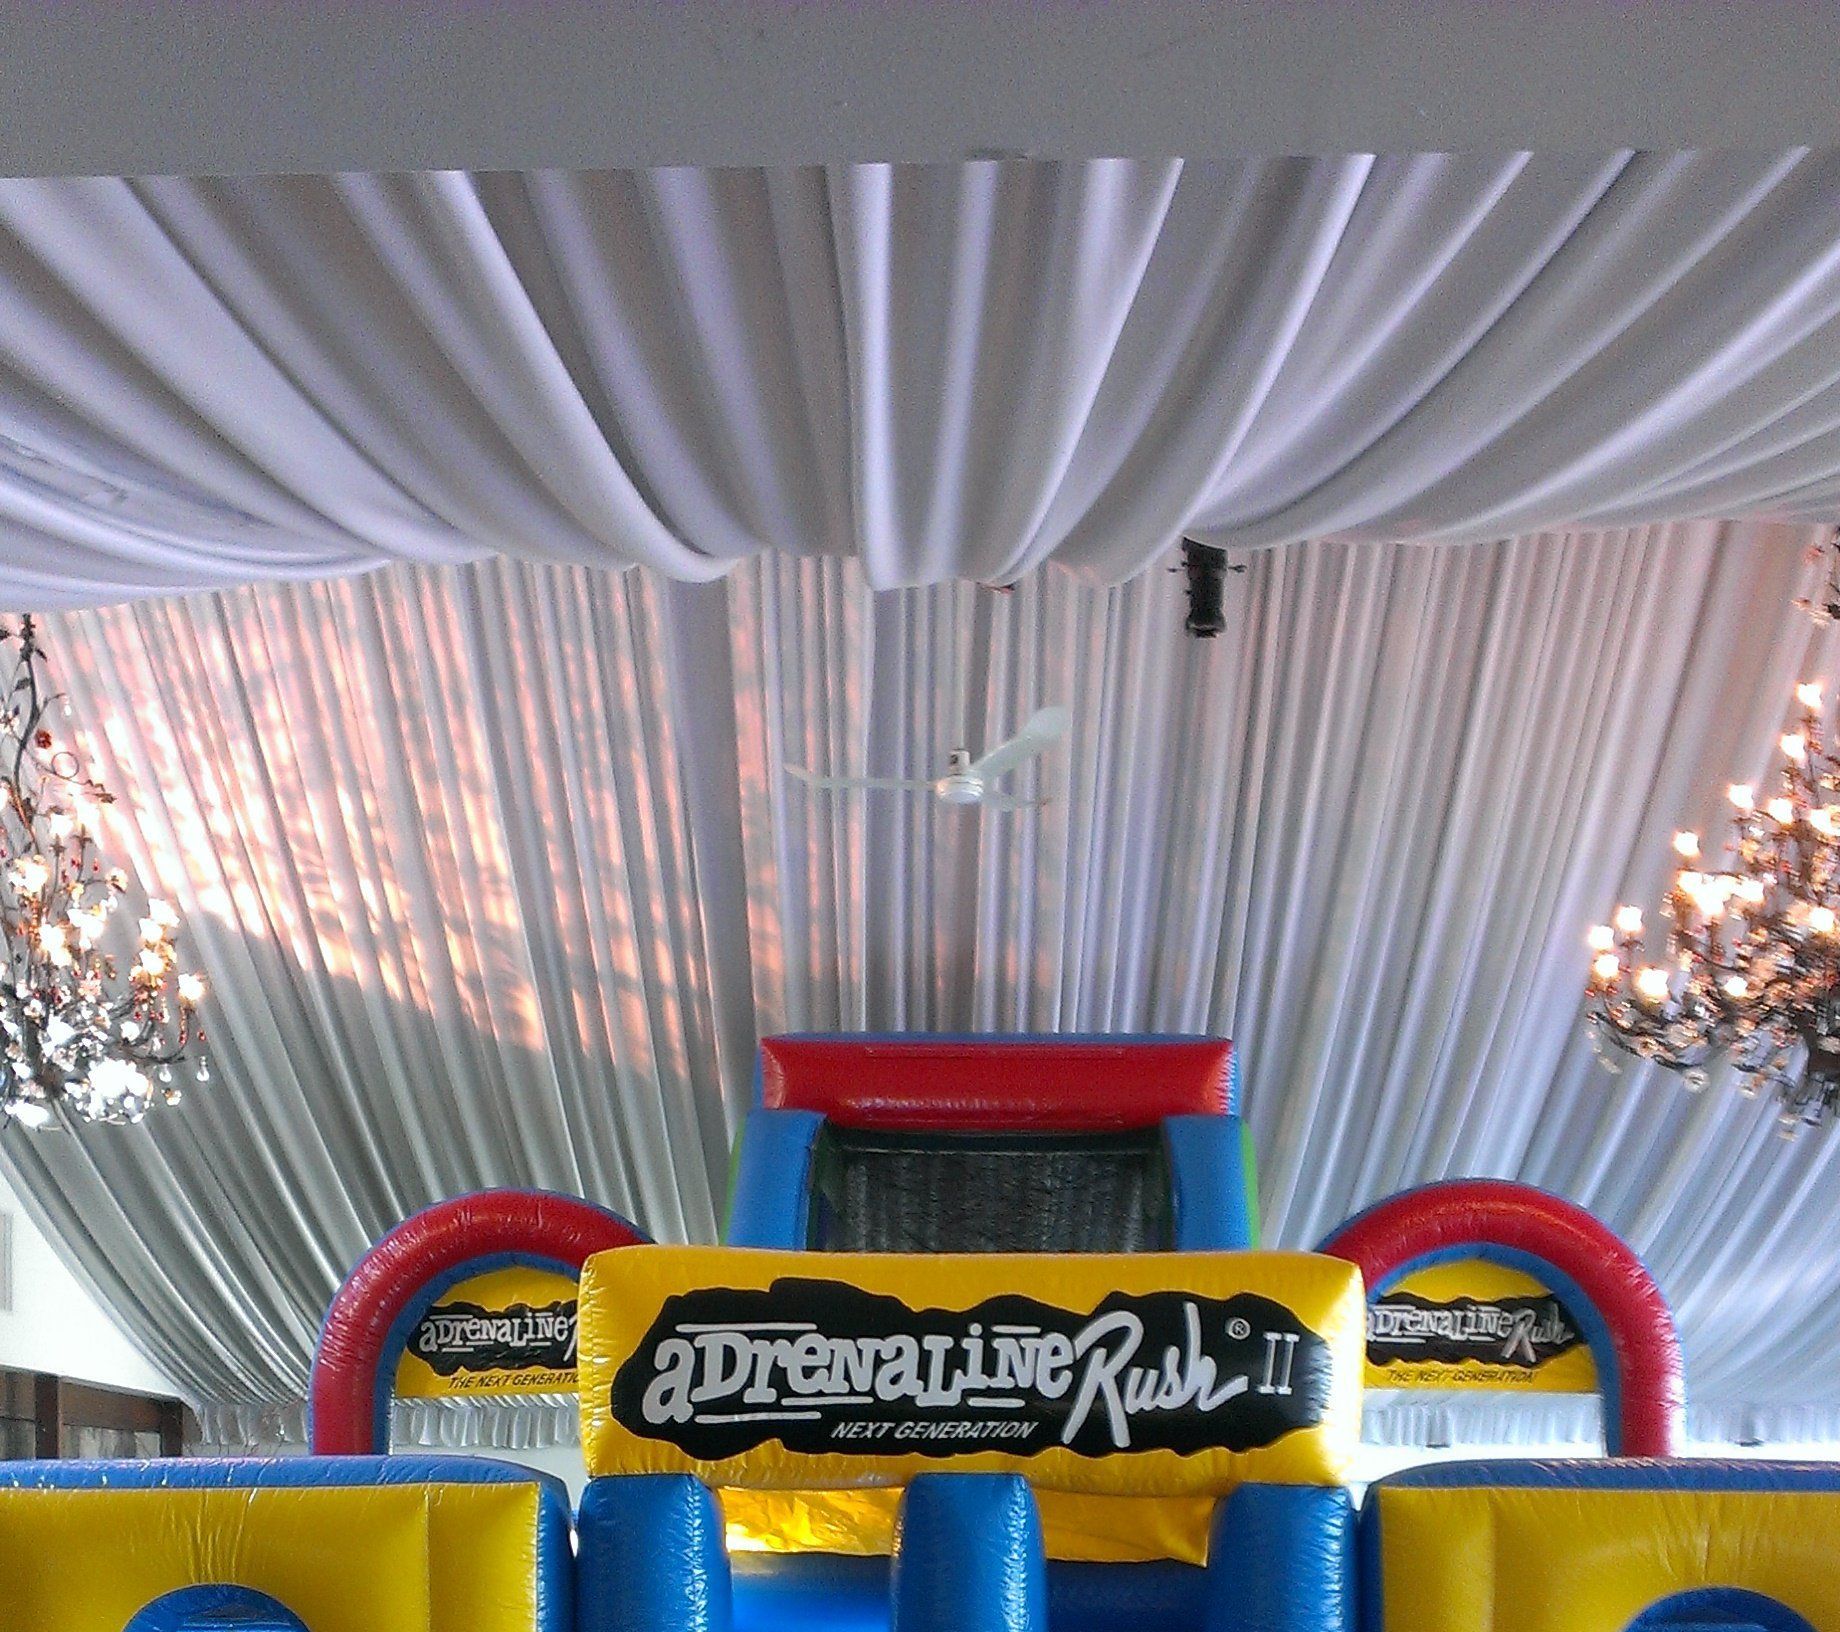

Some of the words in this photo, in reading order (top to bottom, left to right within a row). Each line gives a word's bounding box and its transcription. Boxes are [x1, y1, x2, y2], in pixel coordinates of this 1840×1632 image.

[449, 1376, 476, 1388] THE
[475, 1375, 512, 1388] NEXT
[512, 1372, 579, 1386] GENERATIO
[1060, 1302, 1249, 1448] Rush
[1256, 1331, 1300, 1395] II
[830, 1421, 896, 1439] NEXT
[894, 1421, 1039, 1440] GENERATION
